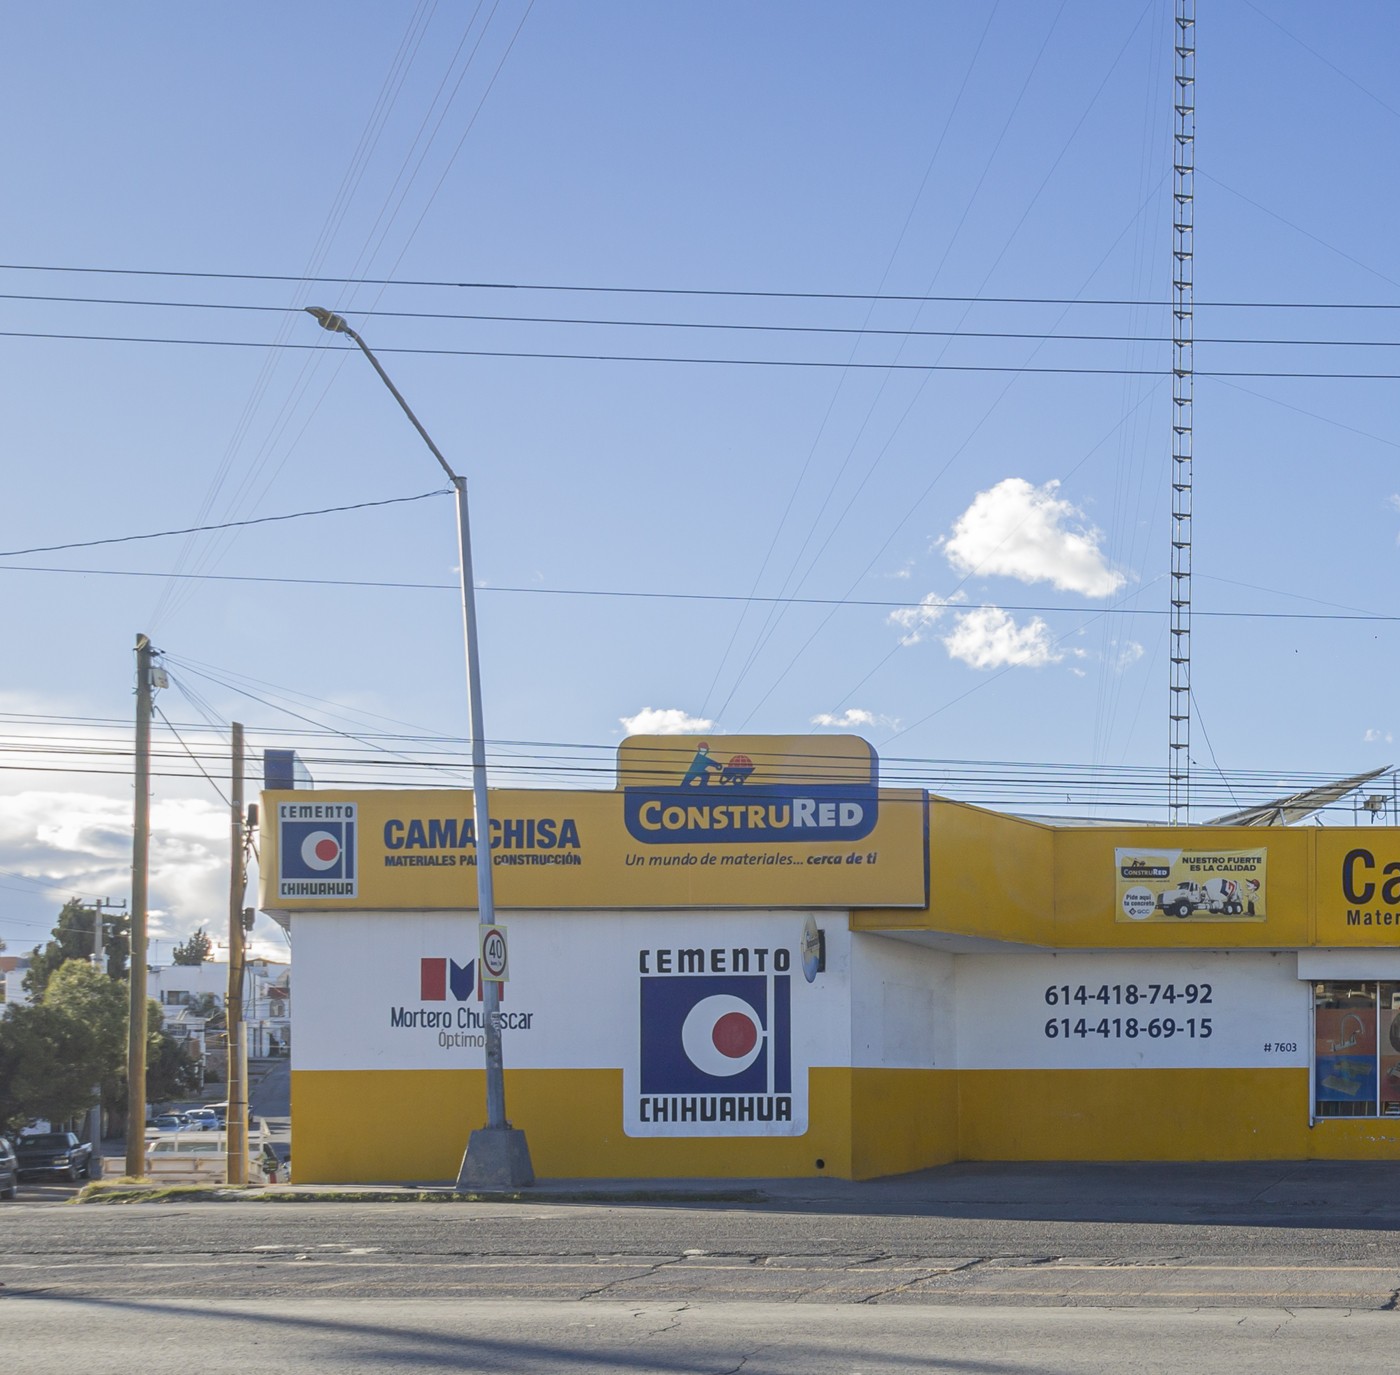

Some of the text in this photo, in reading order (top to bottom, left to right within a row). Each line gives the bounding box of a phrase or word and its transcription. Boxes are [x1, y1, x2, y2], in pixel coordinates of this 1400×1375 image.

[281, 805, 354, 819] CEMENTO
[383, 819, 582, 850] CAMACHISA
[384, 855, 456, 866] MATERIALES
[493, 851, 582, 866] CONSTRUCCIÓN
[625, 852, 877, 866] Un mundo de materiales... cerca de ti
[1216, 864, 1256, 872] CALIDAD
[1227, 856, 1262, 864] FUERTE
[281, 882, 354, 895] CHIHUAHUA
[489, 939, 503, 959] 40
[639, 948, 791, 973] CEMENTO
[1044, 984, 1213, 1005] 614-418-74-92
[391, 1006, 451, 1028] Mortero
[457, 1006, 534, 1030] Chuscar
[1044, 1017, 1213, 1038] 614-418-69-15
[438, 1029, 485, 1050] Óptimo
[1274, 1042, 1297, 1053] 7603
[640, 1096, 792, 1123] CHIHUAHUA
